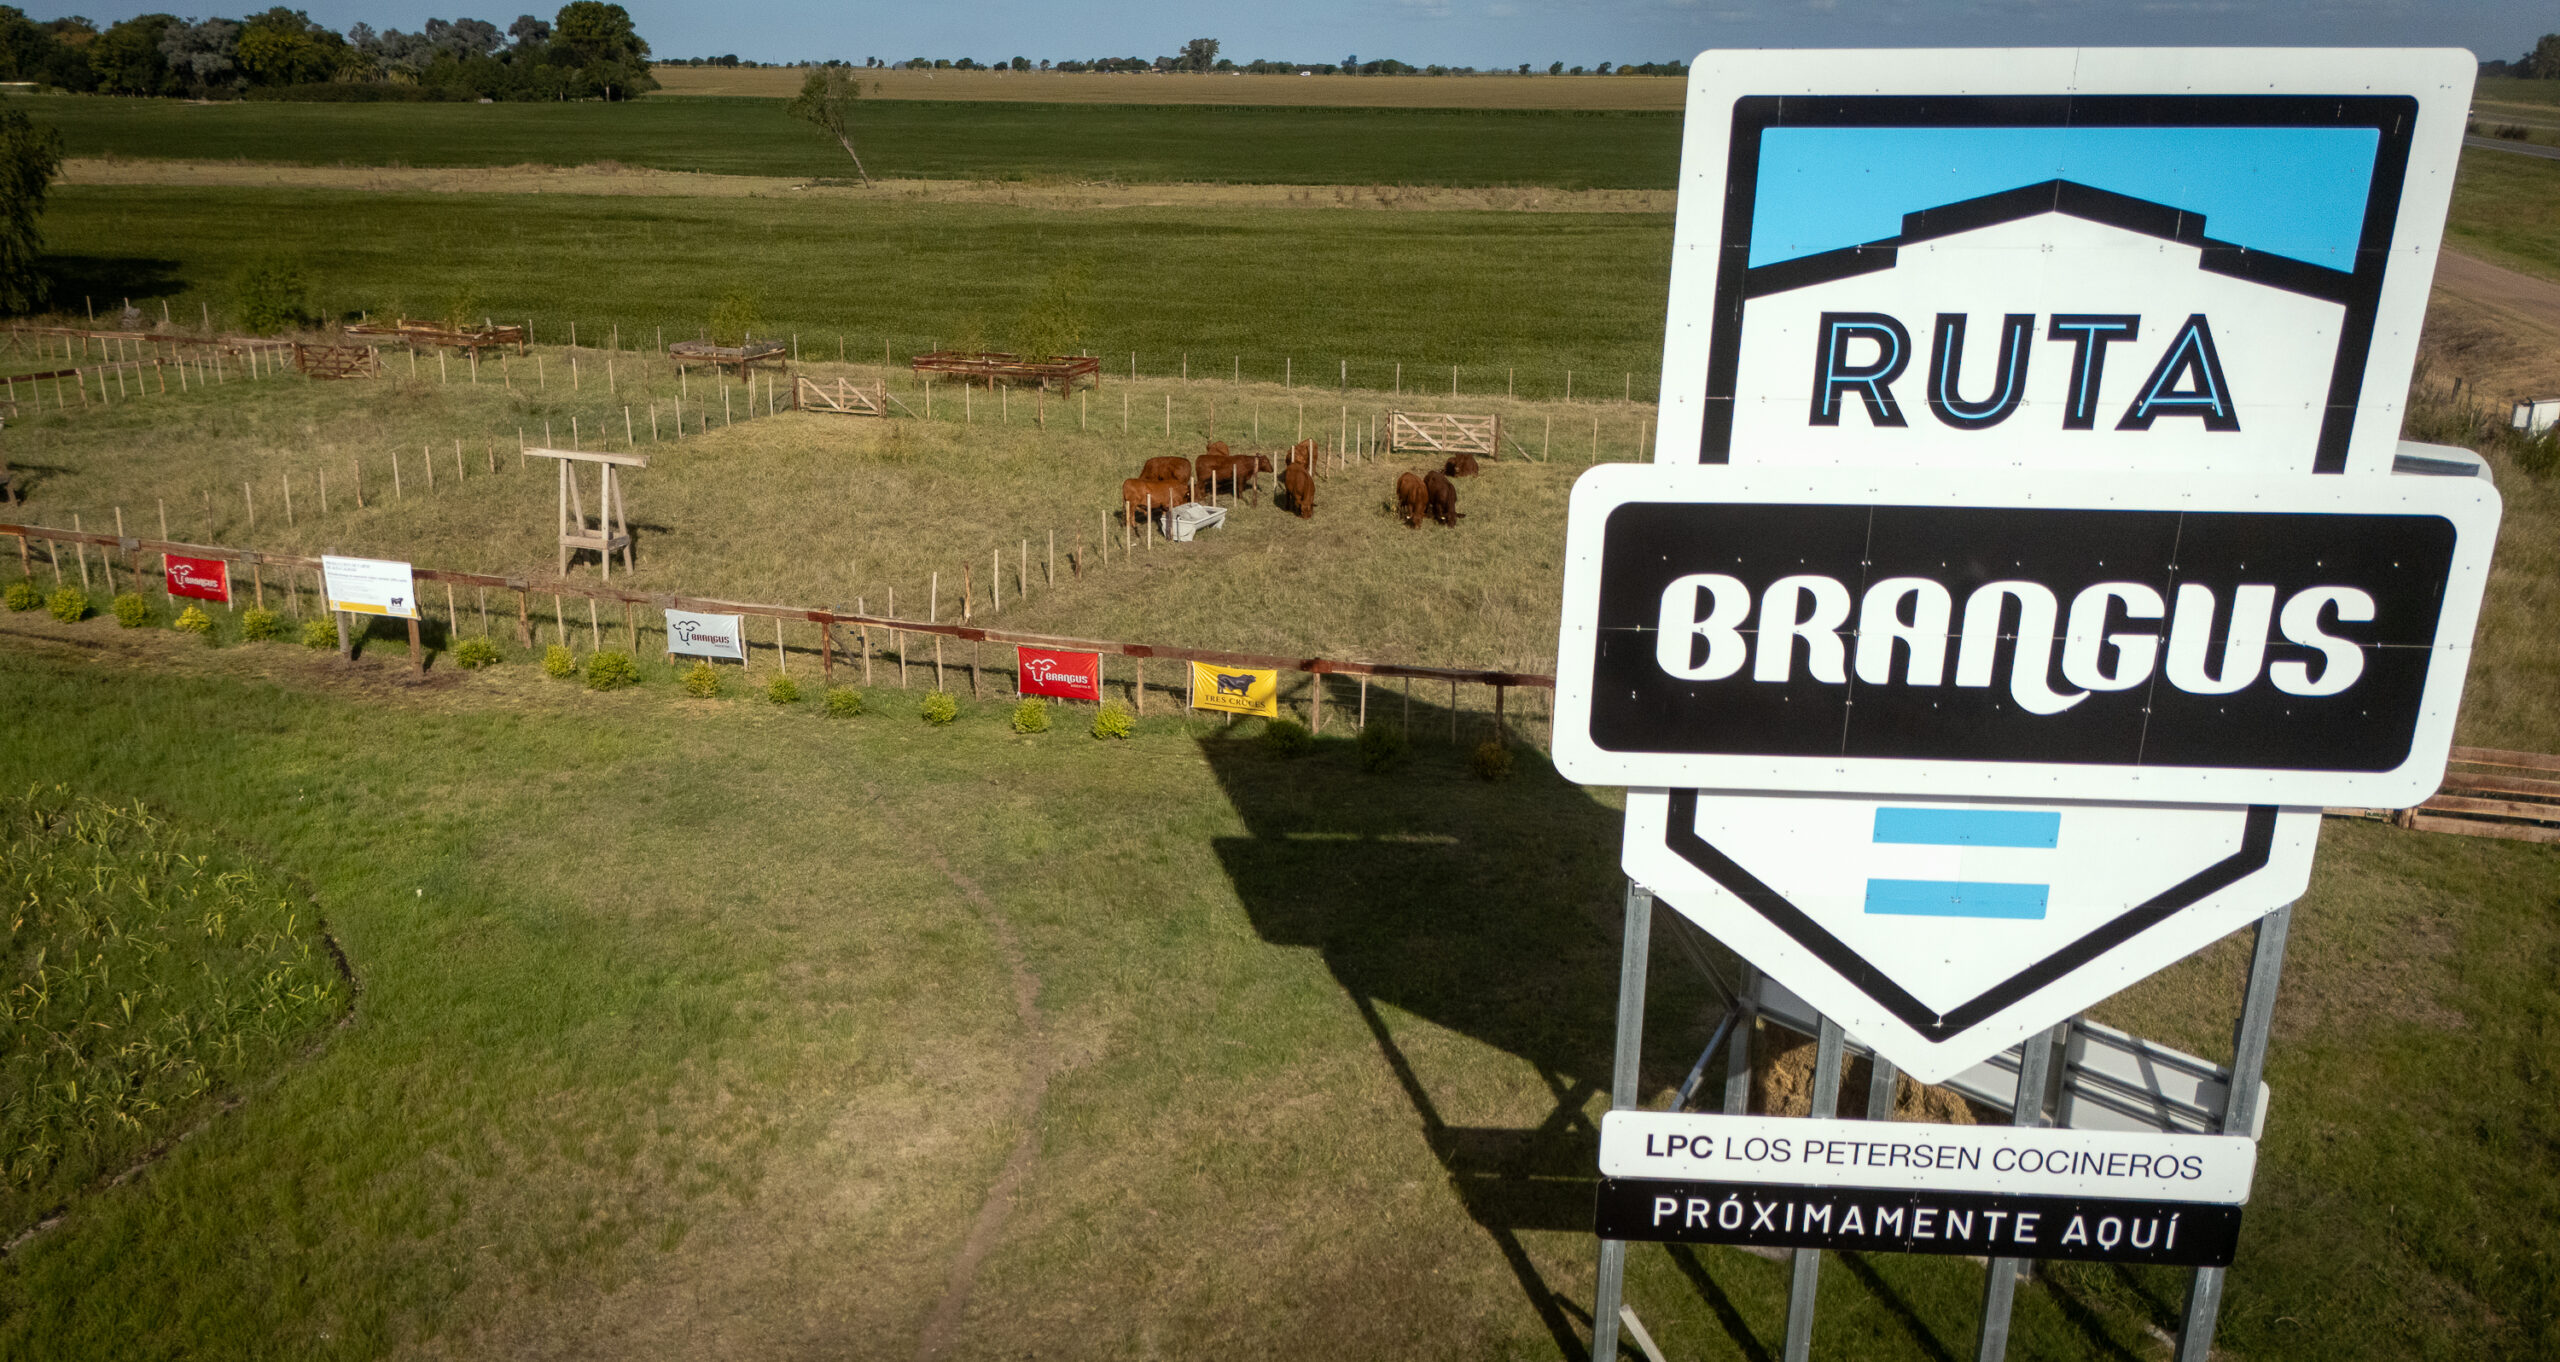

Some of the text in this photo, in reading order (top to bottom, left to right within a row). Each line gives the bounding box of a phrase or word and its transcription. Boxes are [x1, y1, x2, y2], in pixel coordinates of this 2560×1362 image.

[1808, 311, 2241, 432] RUTA
[691, 633, 730, 645] BRANGUS
[1656, 574, 2375, 715] BRANGUS
[1045, 672, 1089, 685] BRANGUS
[1205, 695, 1266, 709] TRES CRUCES
[1646, 1133, 2203, 1180] LPC LOS PETERSEN COCINEROS
[1653, 1193, 2181, 1251] PRÓXIMAMENTE AQUÍ
